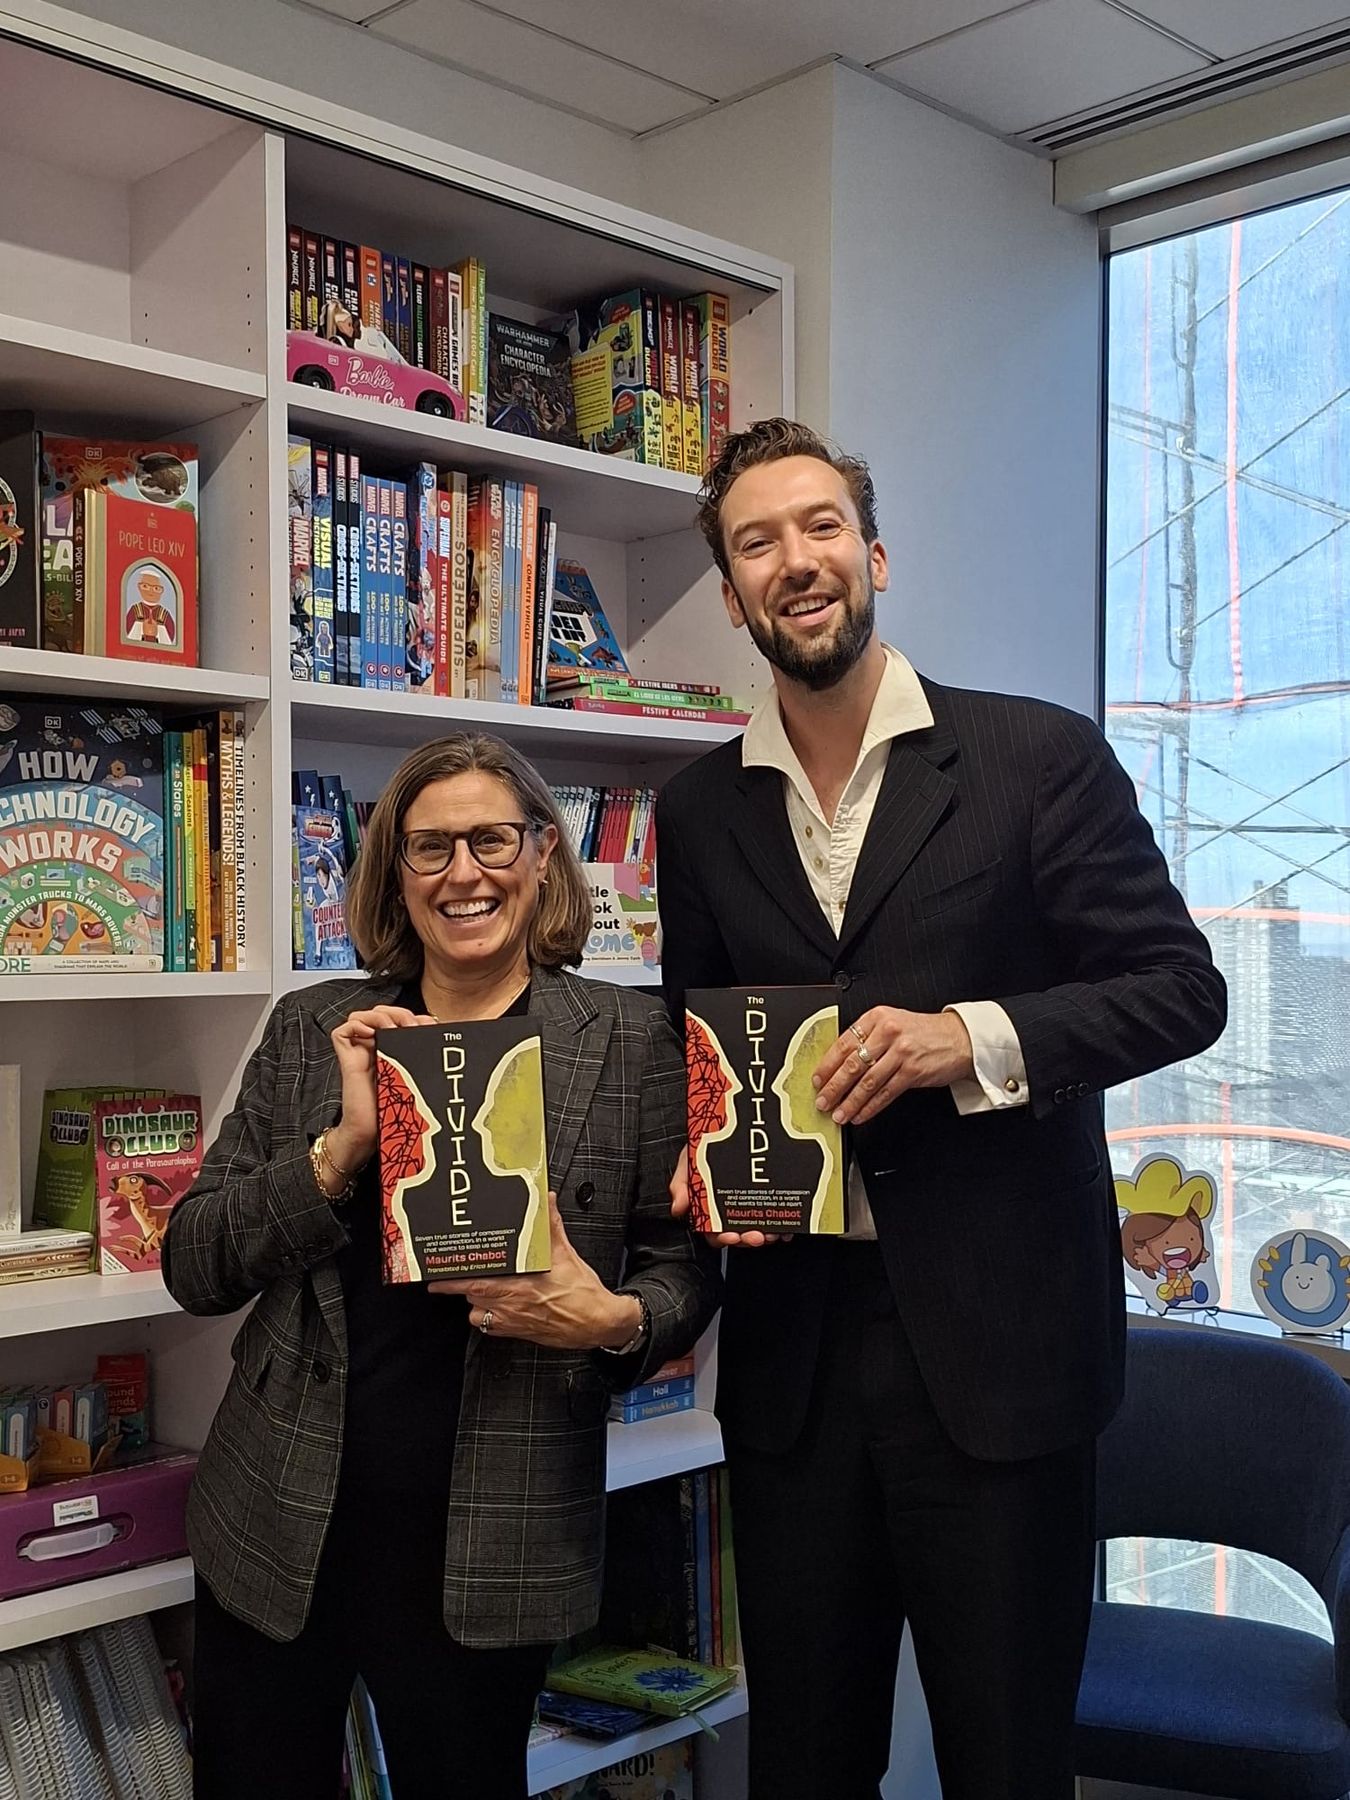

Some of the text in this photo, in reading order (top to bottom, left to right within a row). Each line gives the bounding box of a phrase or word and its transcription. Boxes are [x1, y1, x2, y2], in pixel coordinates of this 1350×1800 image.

[496, 324, 550, 348] WARHAMMER
[712, 322, 720, 370] BUILDER
[718, 325, 729, 374] WORLD
[500, 354, 552, 378] ENCYCLOPEDIA
[504, 344, 546, 364] CHARACTER
[345, 356, 395, 391] Barbie
[670, 355, 679, 394] WORLD
[690, 361, 699, 399] WORLD
[383, 393, 406, 408] Car
[87, 450, 100, 458] DK
[317, 467, 328, 496] MARVEL
[292, 517, 310, 566] MARVEL
[320, 517, 332, 568] VISUAL
[366, 486, 376, 572] MARVEL CRAFTS
[380, 488, 390, 574] MARVEL CRAFTS
[394, 490, 404, 577] MARVEL CRAFTS
[440, 516, 450, 560] SUPERMAN
[118, 531, 186, 559] POPE LEO XIV
[74, 546, 83, 602] POPE LEO XIV
[490, 529, 500, 645] ENCYCLOPEDIA
[453, 540, 465, 666] SUPERHÉROS
[295, 668, 306, 678] DK
[637, 680, 661, 688] FESTIVE
[46, 718, 58, 726] DK
[642, 706, 706, 720] FESTIVE CALENDAR
[18, 751, 98, 782] HOW
[174, 780, 183, 818] States
[220, 740, 234, 866] MYTHS & LEGENDS!
[0, 830, 122, 873] WORKS
[235, 746, 246, 948] TIMELINES FROM BLACK HISTORY
[3, 890, 122, 947] MONSTER TRUCKS TO MARS ROVERS
[312, 902, 343, 924] COUNTE
[594, 918, 620, 930] out
[747, 996, 764, 1005] The
[444, 1032, 462, 1042] The
[746, 1010, 770, 1183] DIVIDE
[52, 1111, 90, 1128] DINOSAUR
[104, 1112, 199, 1136] DINOSAUR
[58, 1128, 82, 1142] CLUB
[126, 1133, 179, 1155] CLUB
[442, 1046, 472, 1226] DIVIDE
[106, 1156, 198, 1172] Call of the Parasaurolophus
[726, 1209, 802, 1218] Maurits Chabot
[479, 1228, 516, 1238] compassion
[490, 1241, 508, 1249] apart
[426, 1250, 507, 1265] Maurits Chabot
[428, 1265, 460, 1274] Translated
[460, 1264, 468, 1272] by
